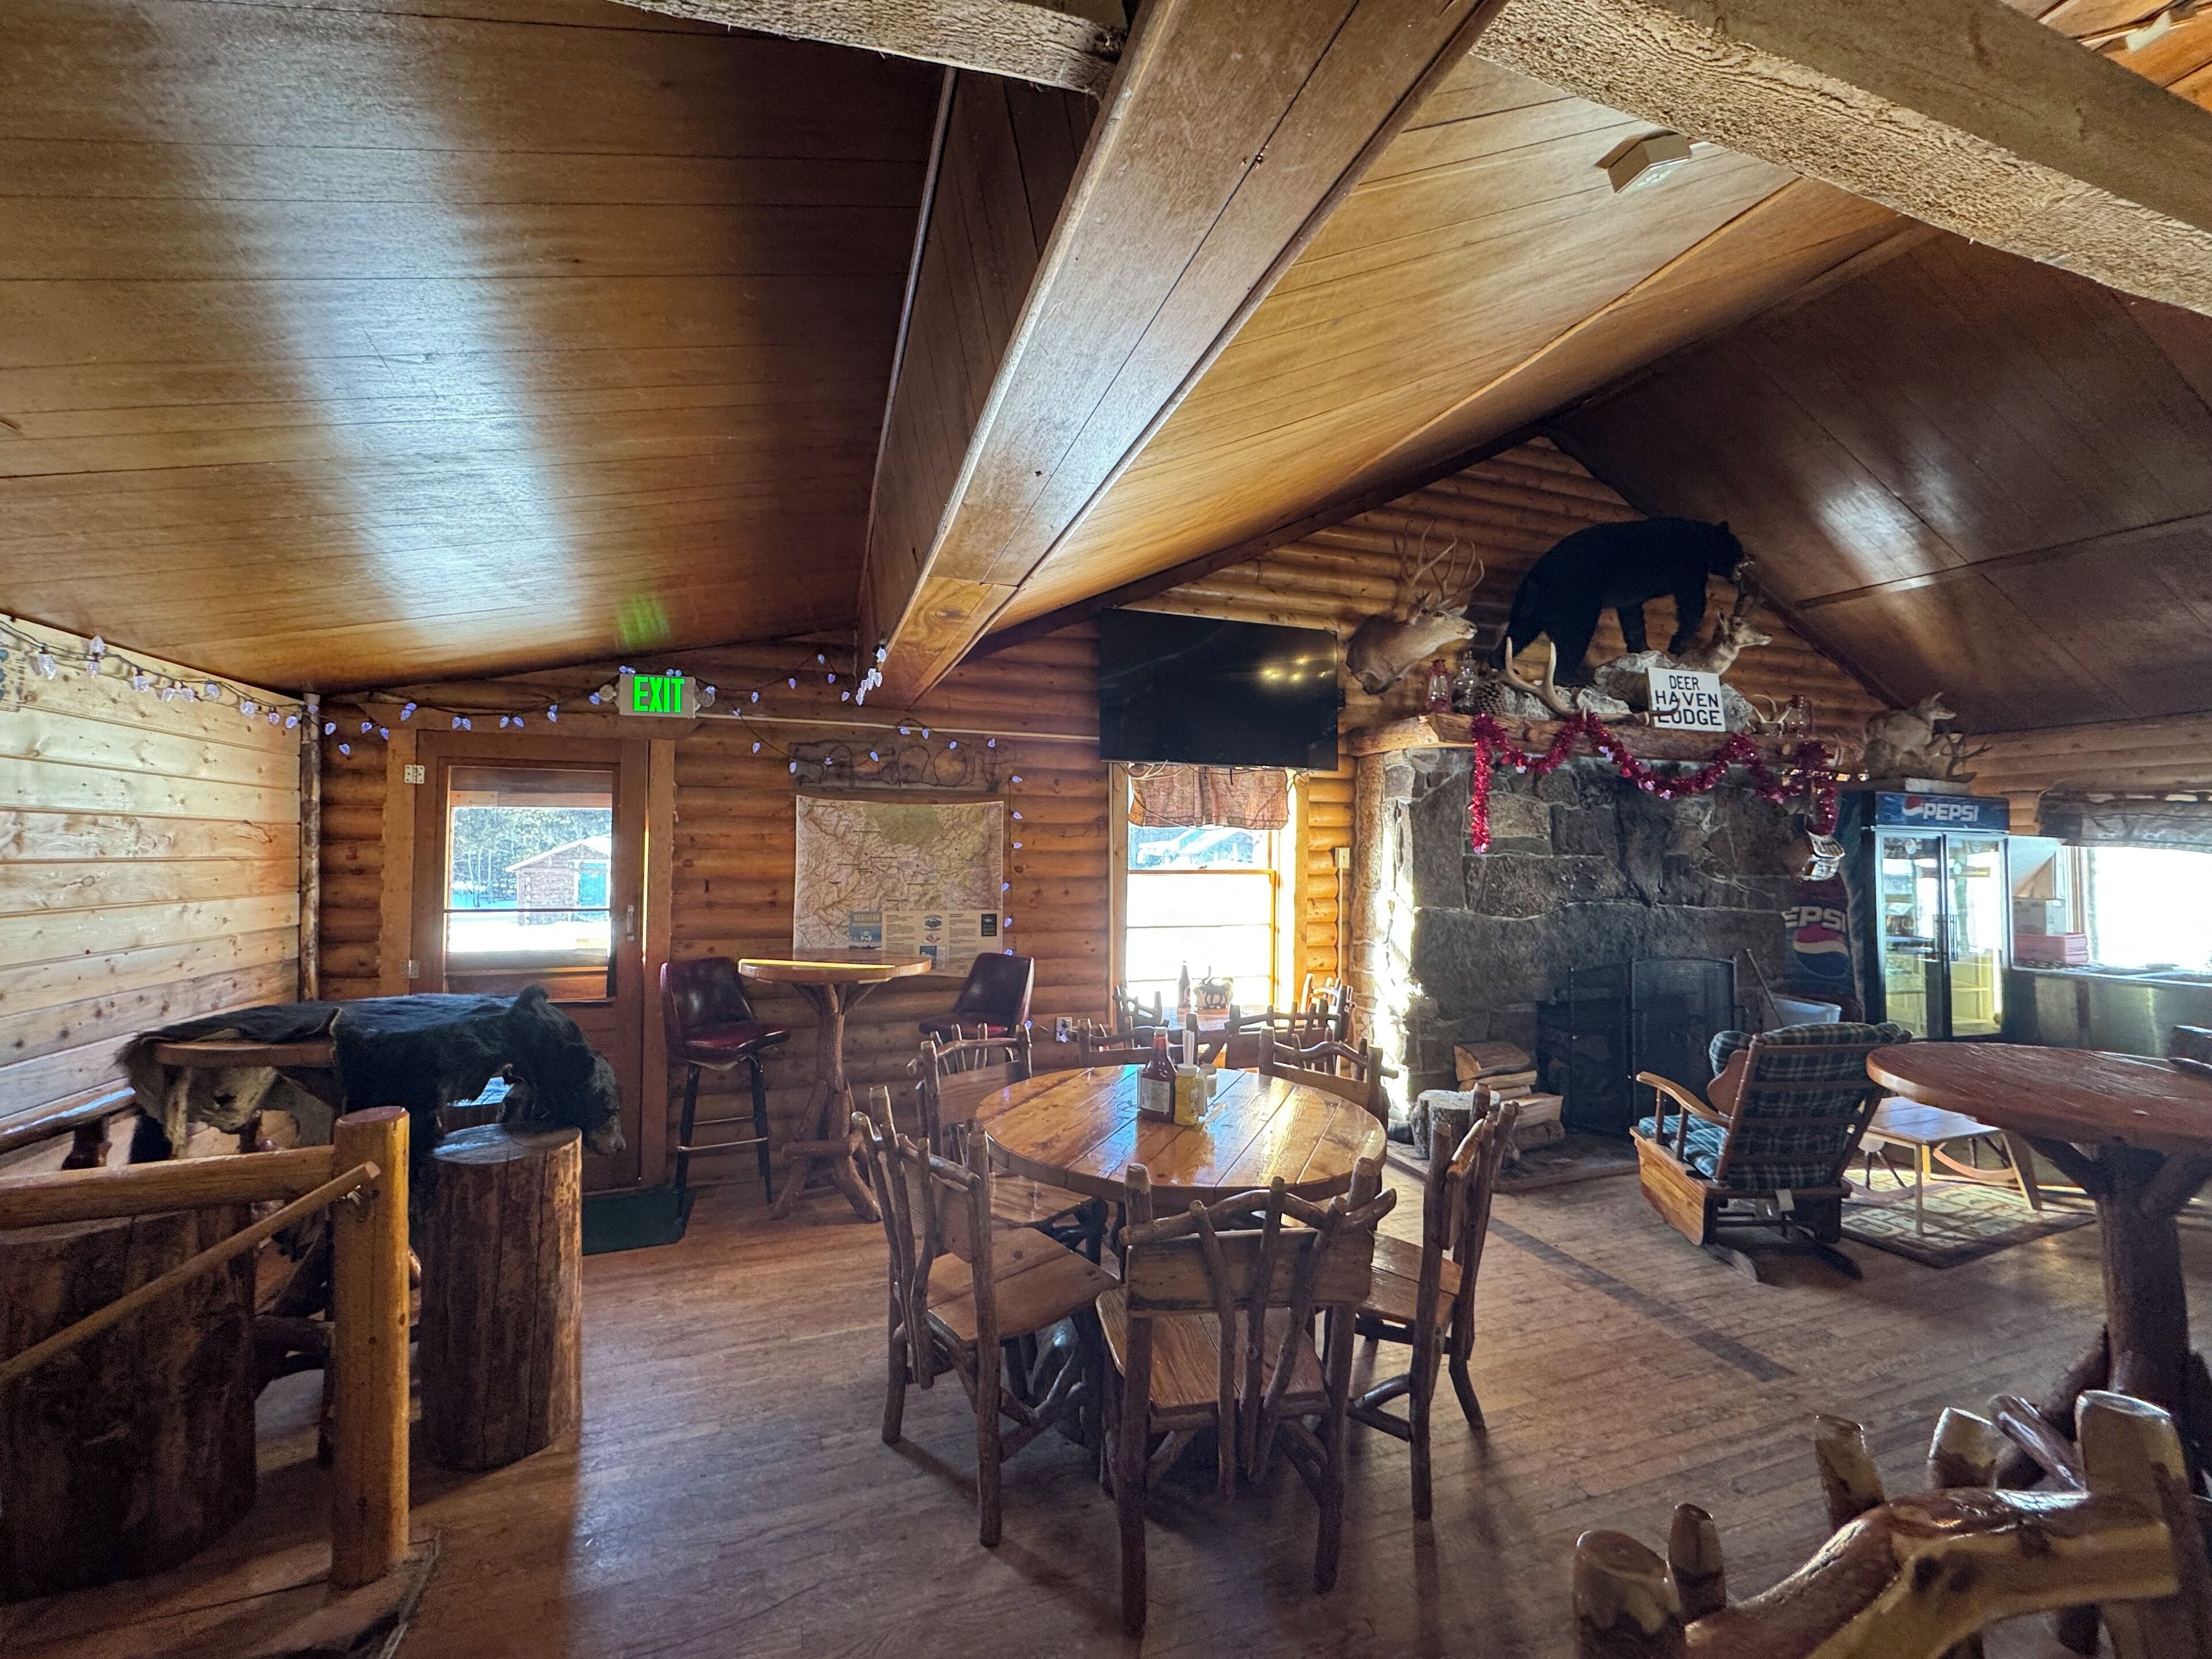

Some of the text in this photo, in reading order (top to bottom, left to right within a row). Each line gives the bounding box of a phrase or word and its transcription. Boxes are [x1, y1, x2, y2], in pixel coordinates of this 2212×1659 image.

[1669, 675, 1700, 691] DEER
[634, 676, 685, 713] EXIT
[1655, 690, 1719, 708] HAVEN
[1656, 707, 1722, 726] LODGE
[1922, 802, 1979, 822] PEPSI
[1781, 906, 1846, 934] EPSI
